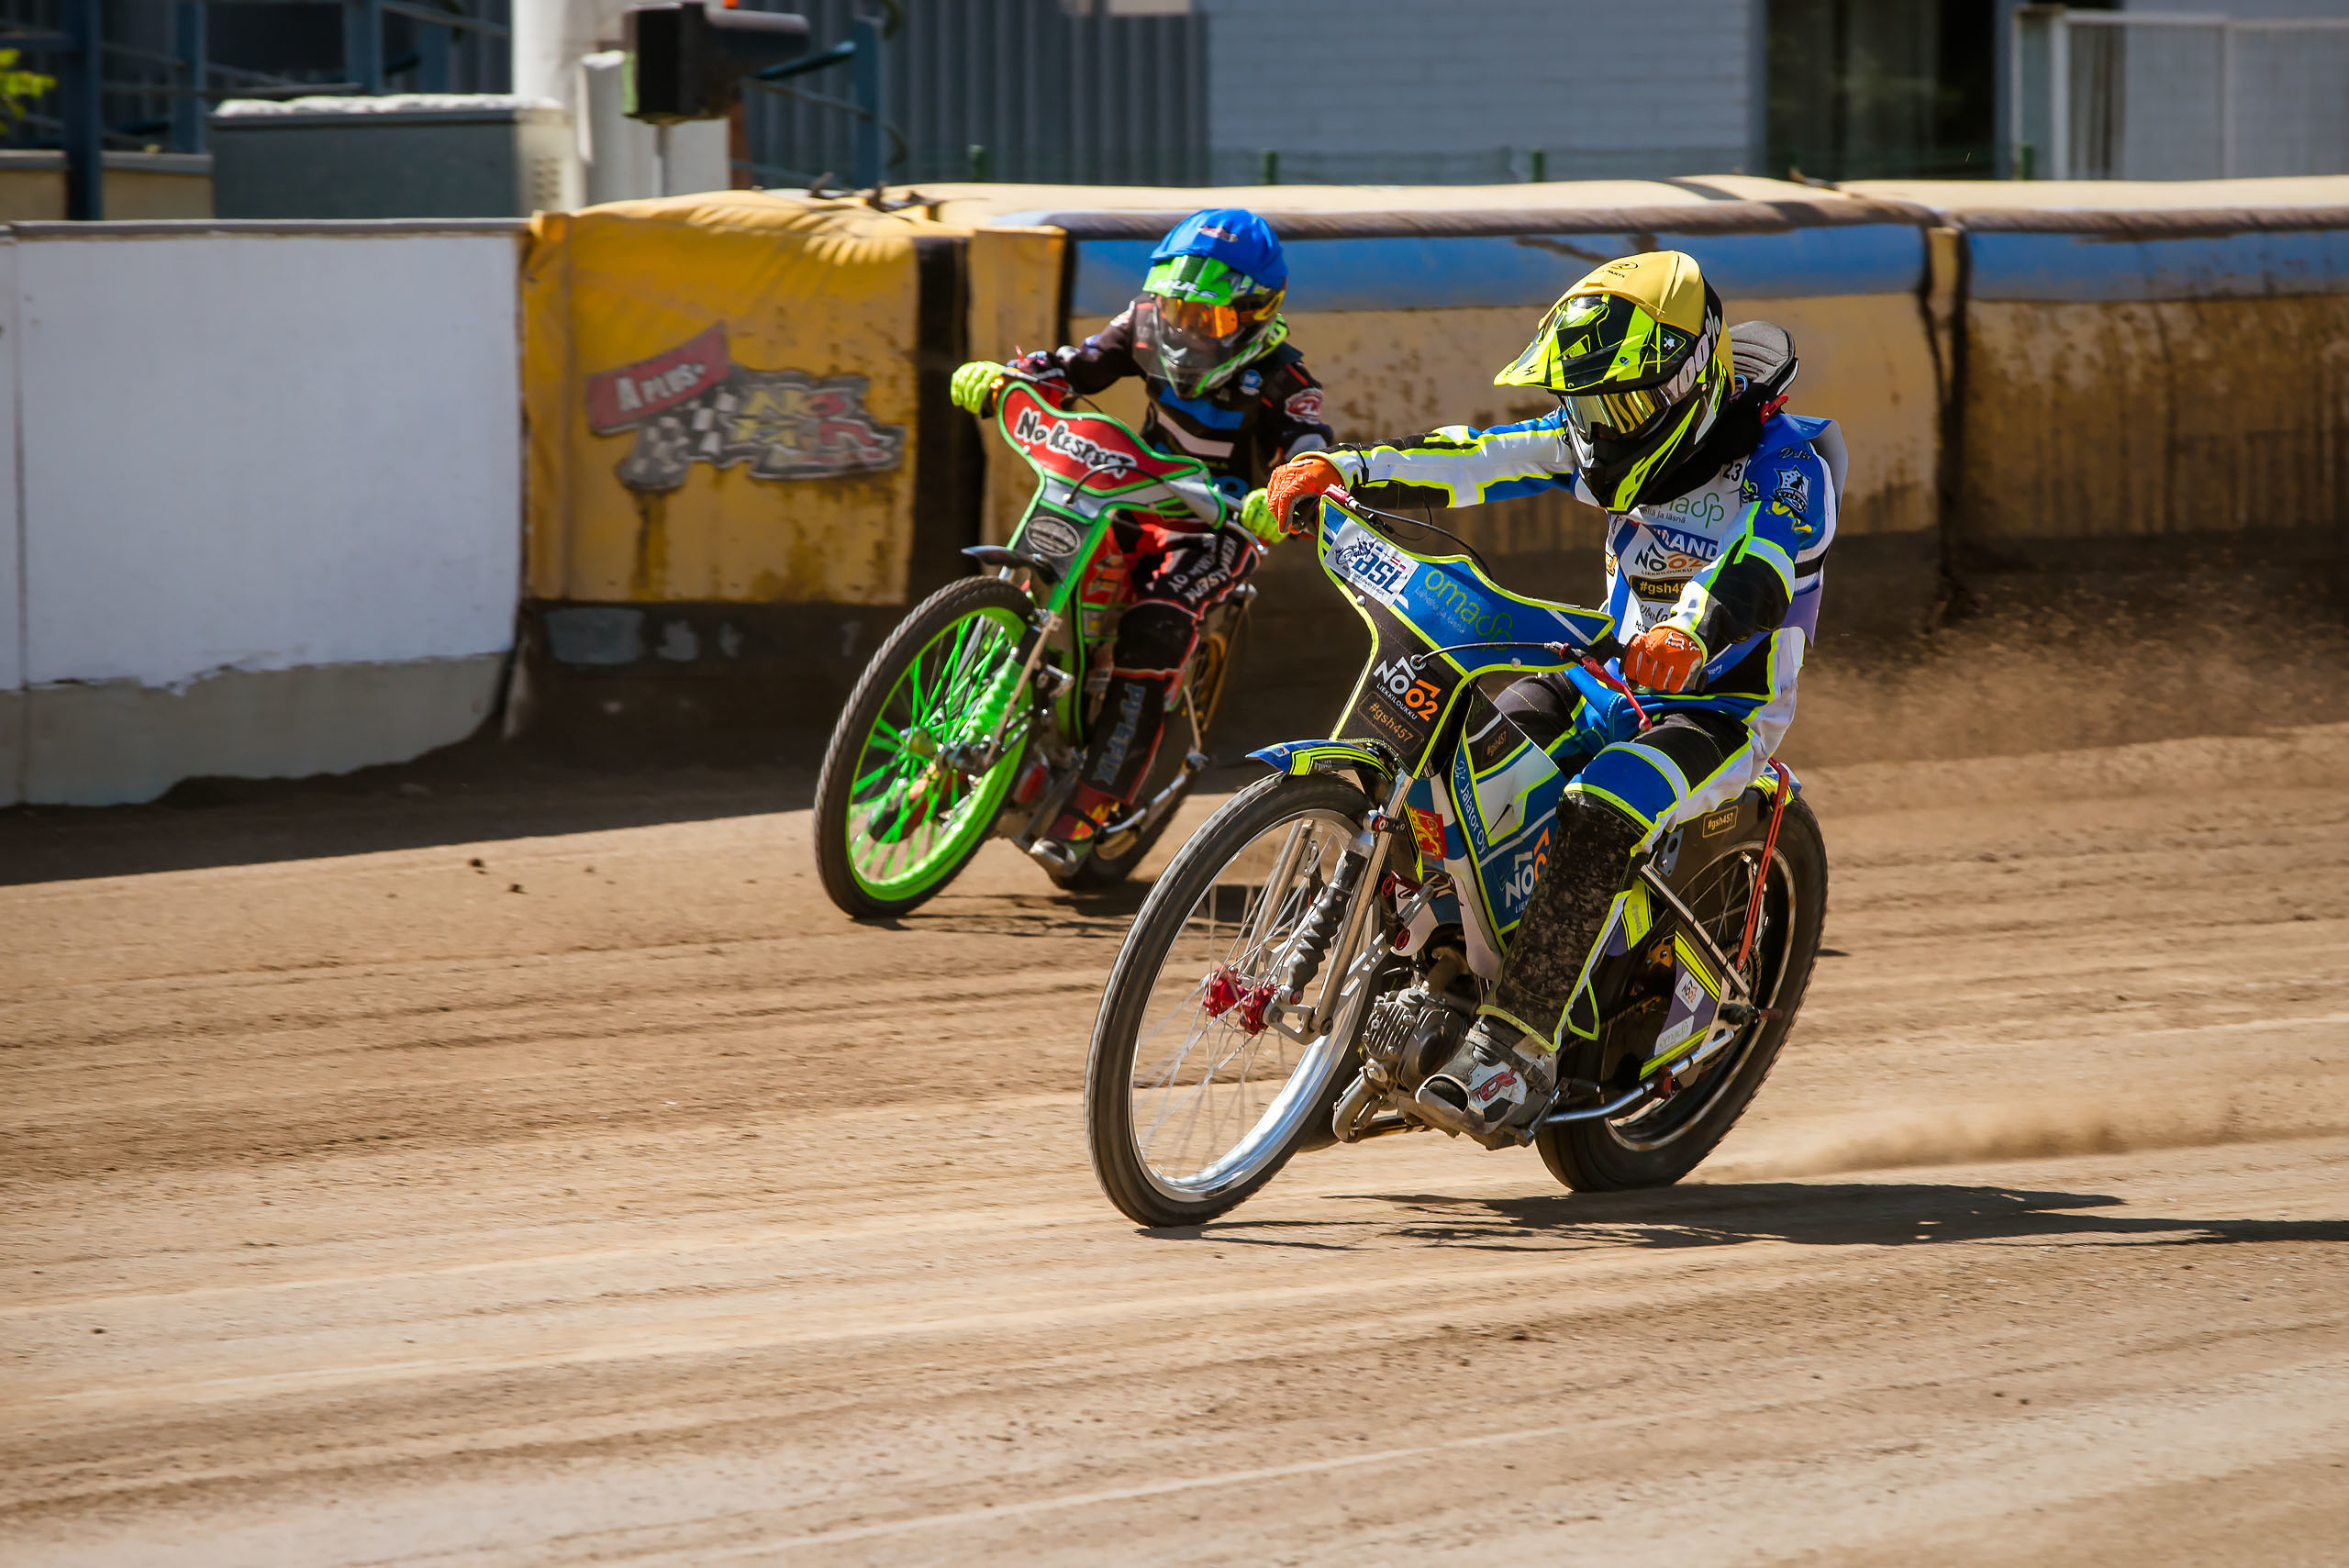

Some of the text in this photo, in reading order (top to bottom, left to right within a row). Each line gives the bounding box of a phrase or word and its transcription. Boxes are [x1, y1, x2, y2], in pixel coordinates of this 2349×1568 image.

[1666, 304, 1722, 399] 100%
[1351, 552, 1403, 595] BSL
[1375, 682, 1418, 720] LIEKKILOUKKU
[1368, 702, 1415, 743] #gsh457
[1460, 781, 1486, 855] Jalator Oy
[1708, 812, 1733, 830] #gsh457
